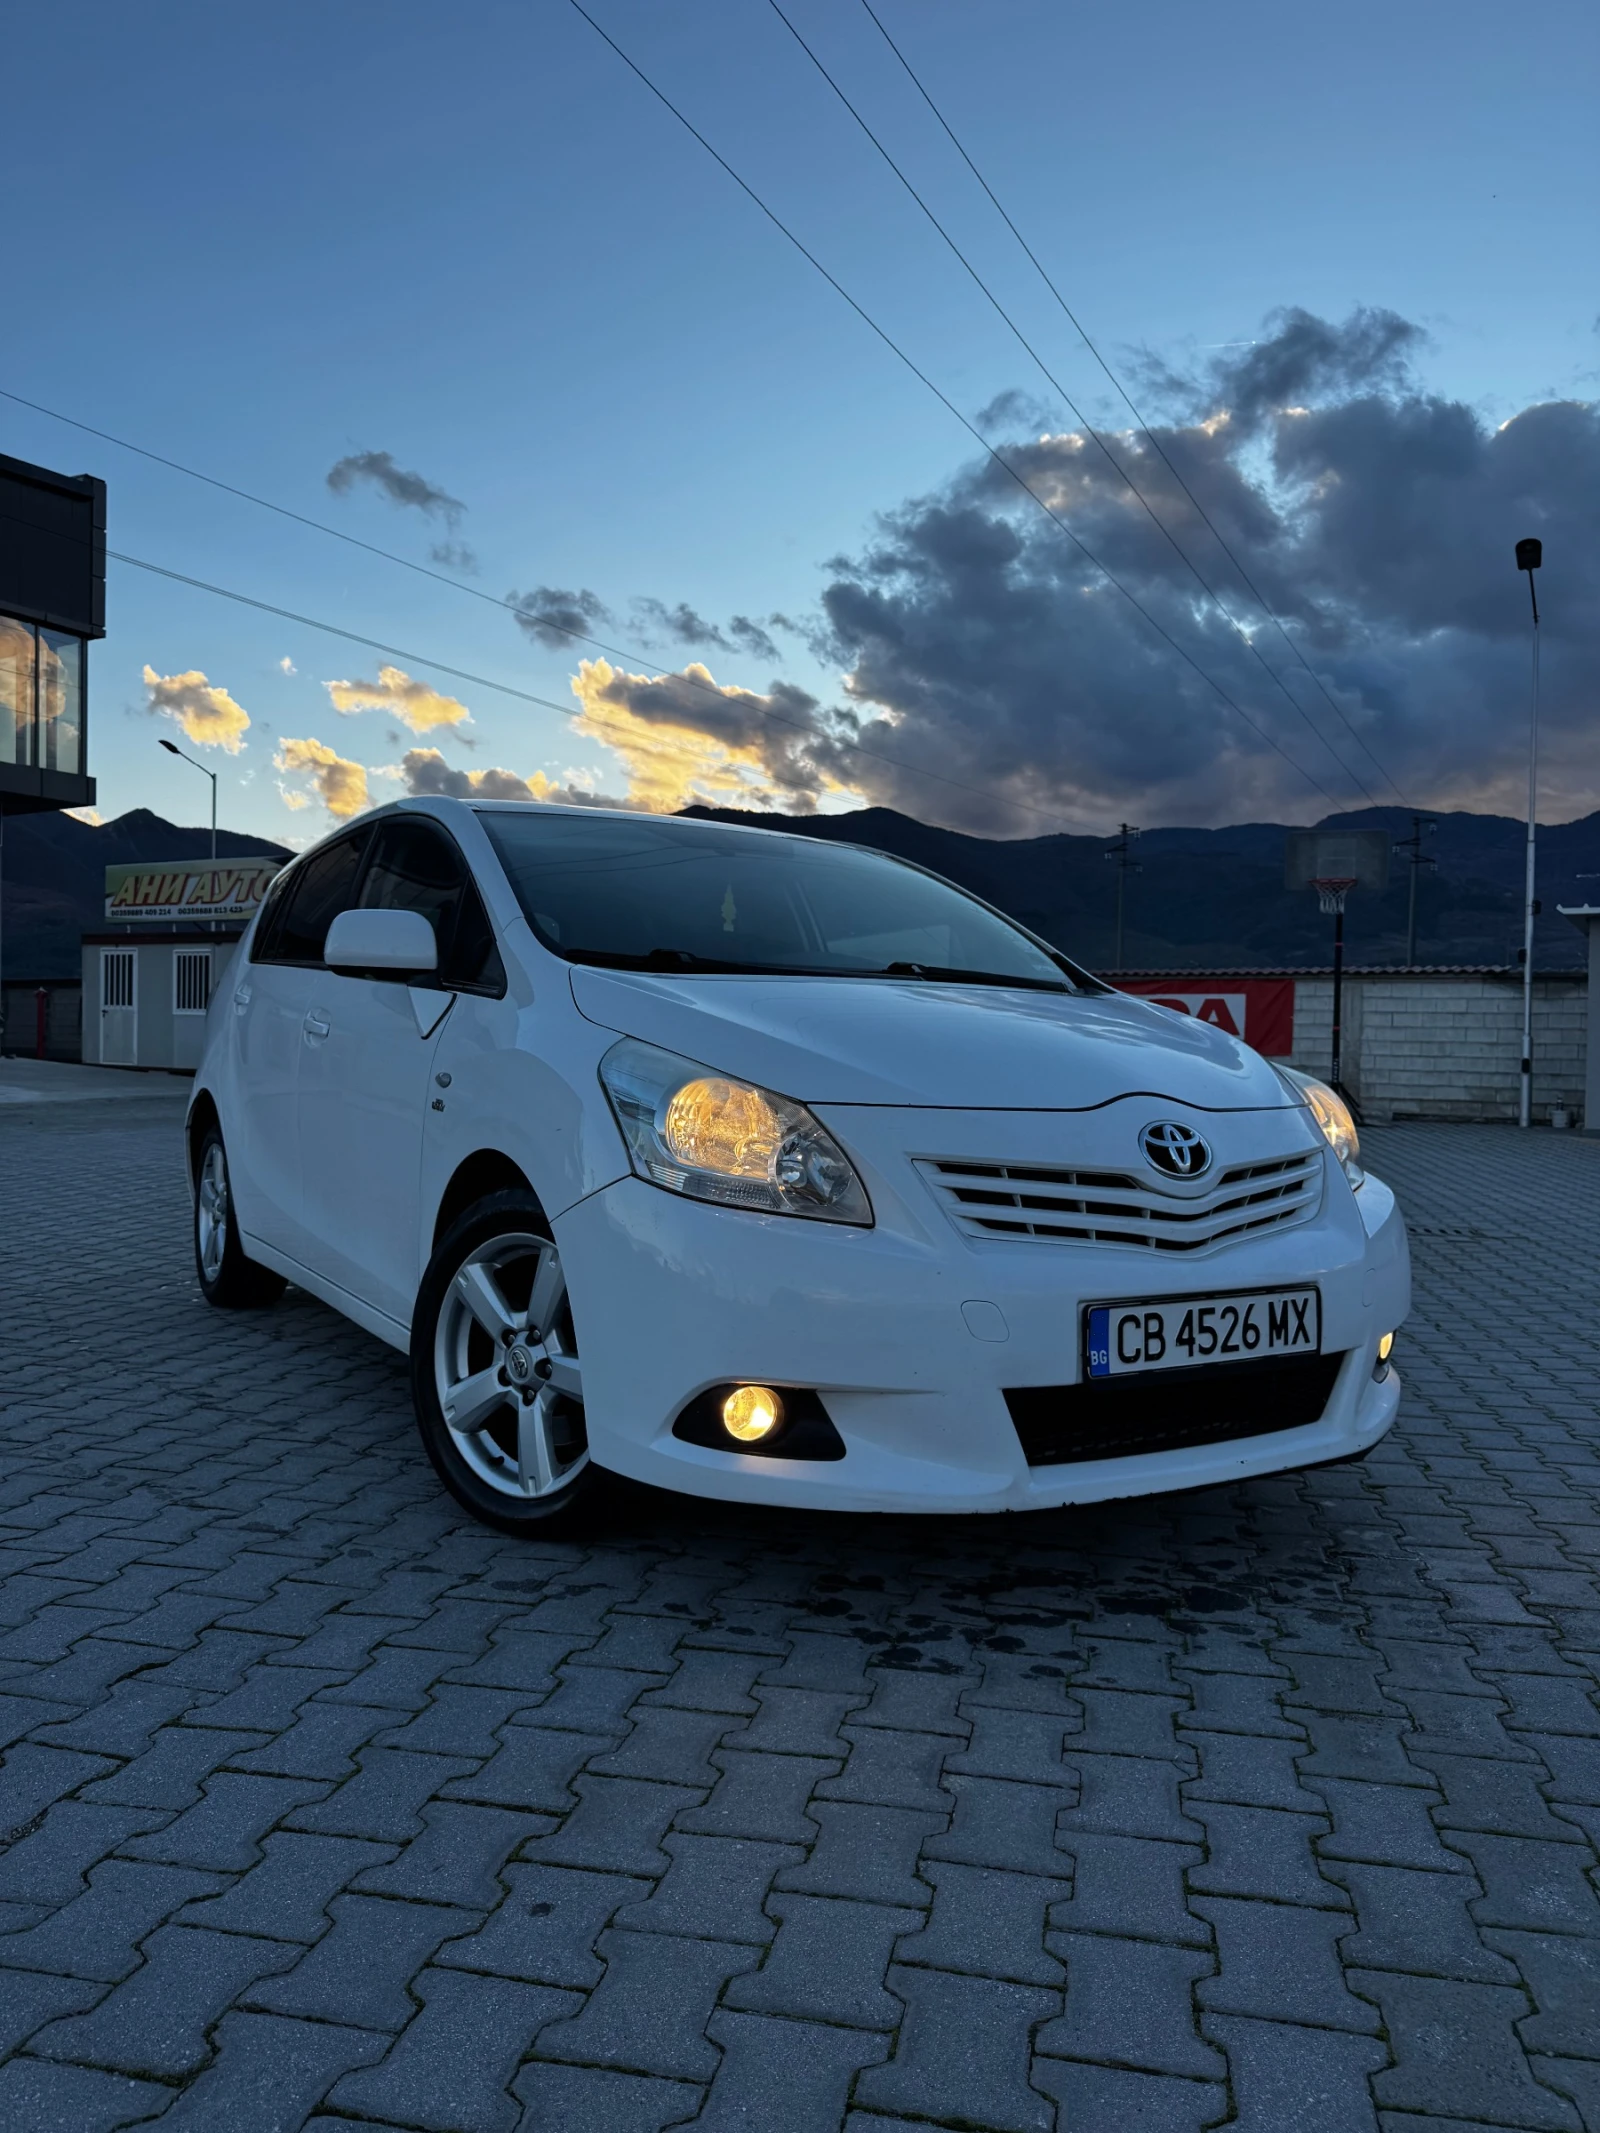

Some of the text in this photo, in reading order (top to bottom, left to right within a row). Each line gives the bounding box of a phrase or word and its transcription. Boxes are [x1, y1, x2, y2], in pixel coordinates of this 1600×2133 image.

[110, 872, 190, 907] АНИ
[1117, 1297, 1310, 1364] CB 4526 MX
[1090, 1349, 1108, 1366] BG
